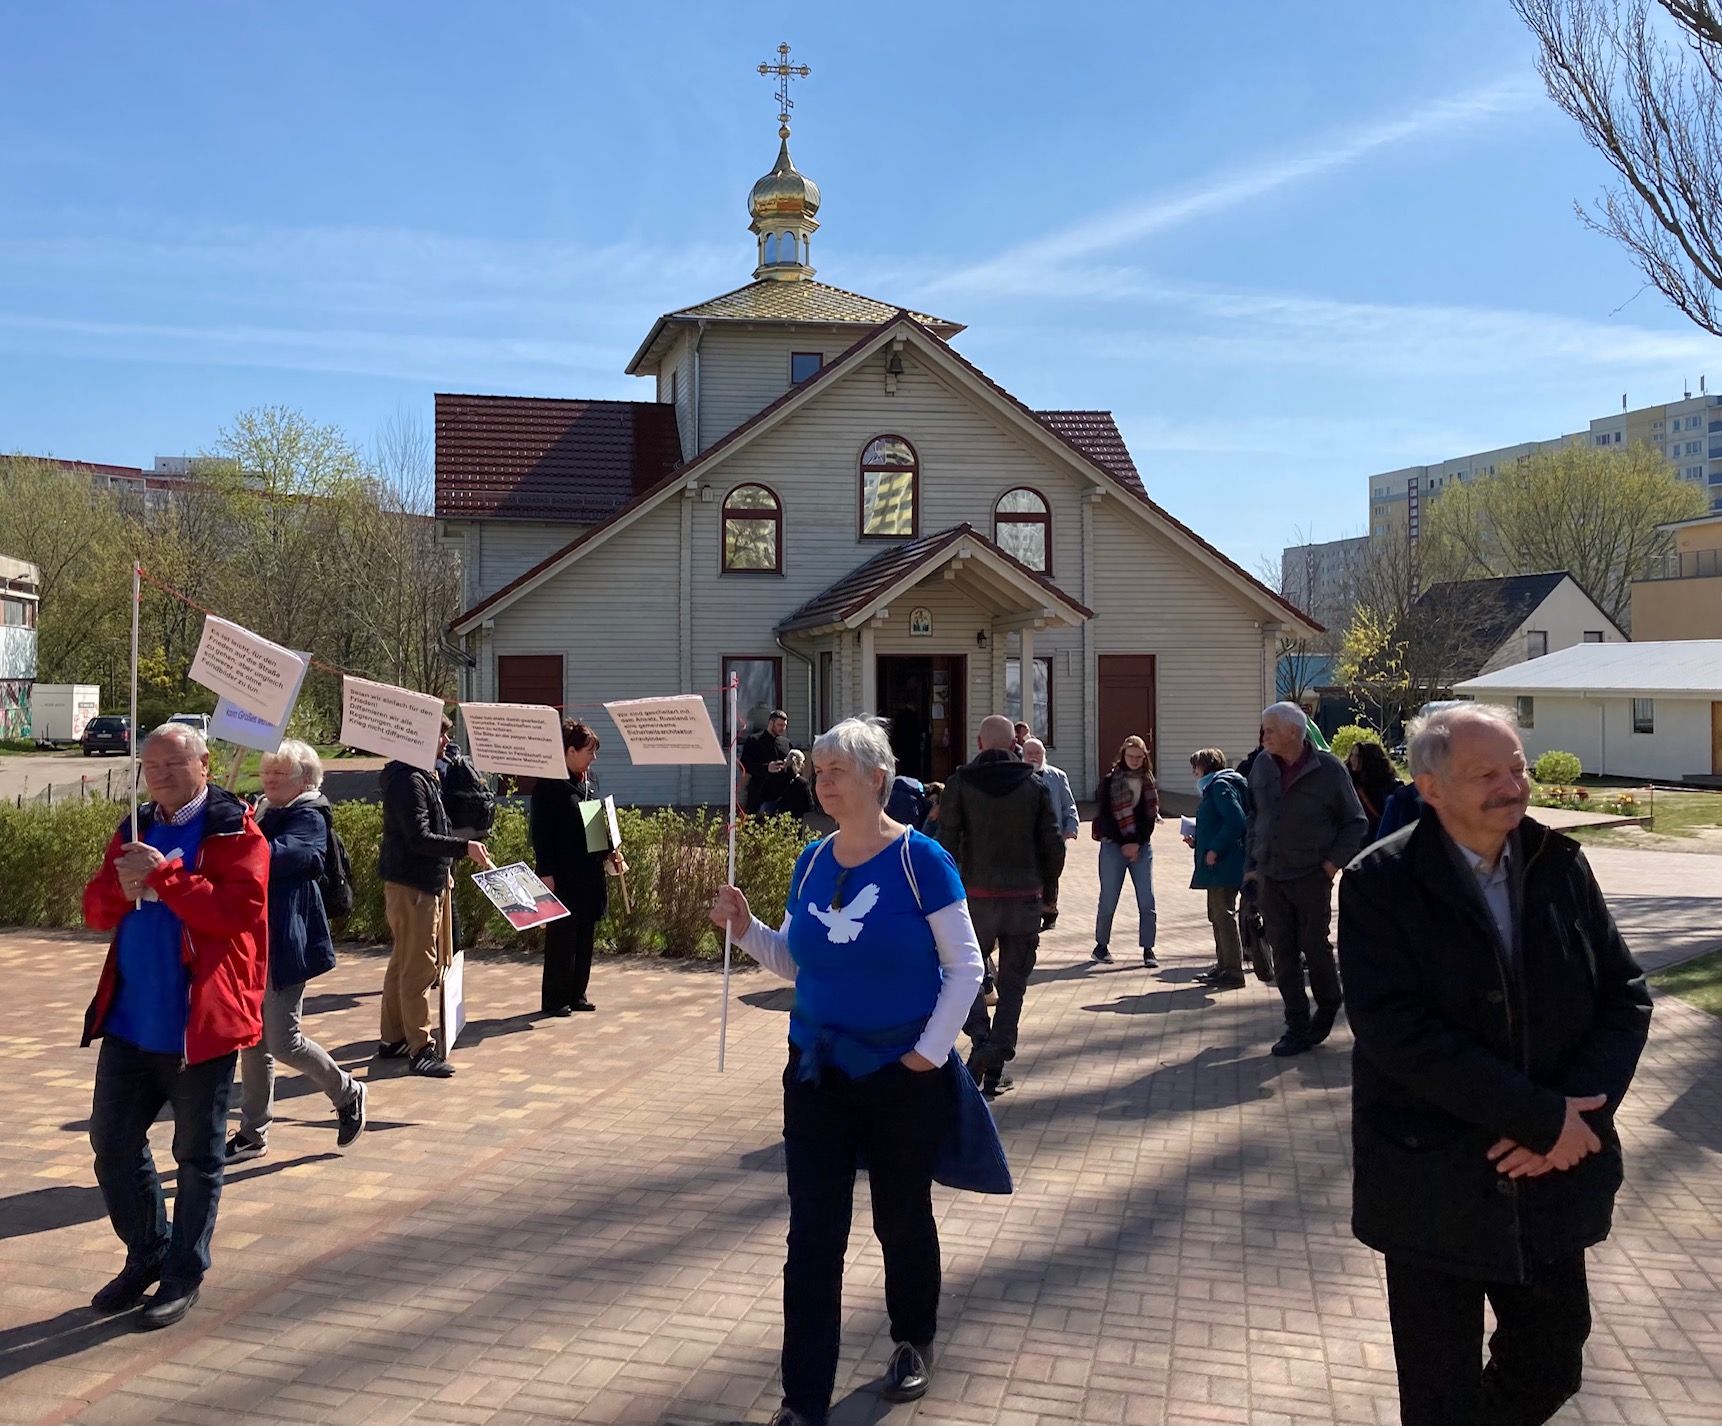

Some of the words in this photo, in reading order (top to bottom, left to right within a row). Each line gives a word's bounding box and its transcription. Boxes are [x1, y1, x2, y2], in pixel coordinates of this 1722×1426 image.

[209, 636, 233, 652] Frieden
[235, 651, 246, 659] auf
[247, 656, 256, 665] die
[258, 663, 280, 678] Straße
[222, 634, 230, 642] ist
[231, 639, 250, 654] leicht,
[252, 651, 262, 659] für
[264, 657, 276, 666] den
[202, 658, 237, 681] Feindbilder
[238, 662, 253, 673] aber
[254, 670, 283, 689] ungleich
[246, 674, 262, 686] ohne
[350, 689, 369, 697] Seien
[383, 698, 407, 709] einfach
[350, 696, 378, 708] Frieden!
[238, 710, 257, 723] Großes
[350, 703, 387, 718] Diffamieren
[350, 711, 392, 728] Regierungen,
[349, 718, 366, 728] Krieg
[368, 724, 384, 733] nicht
[386, 730, 424, 745] diffamieren!
